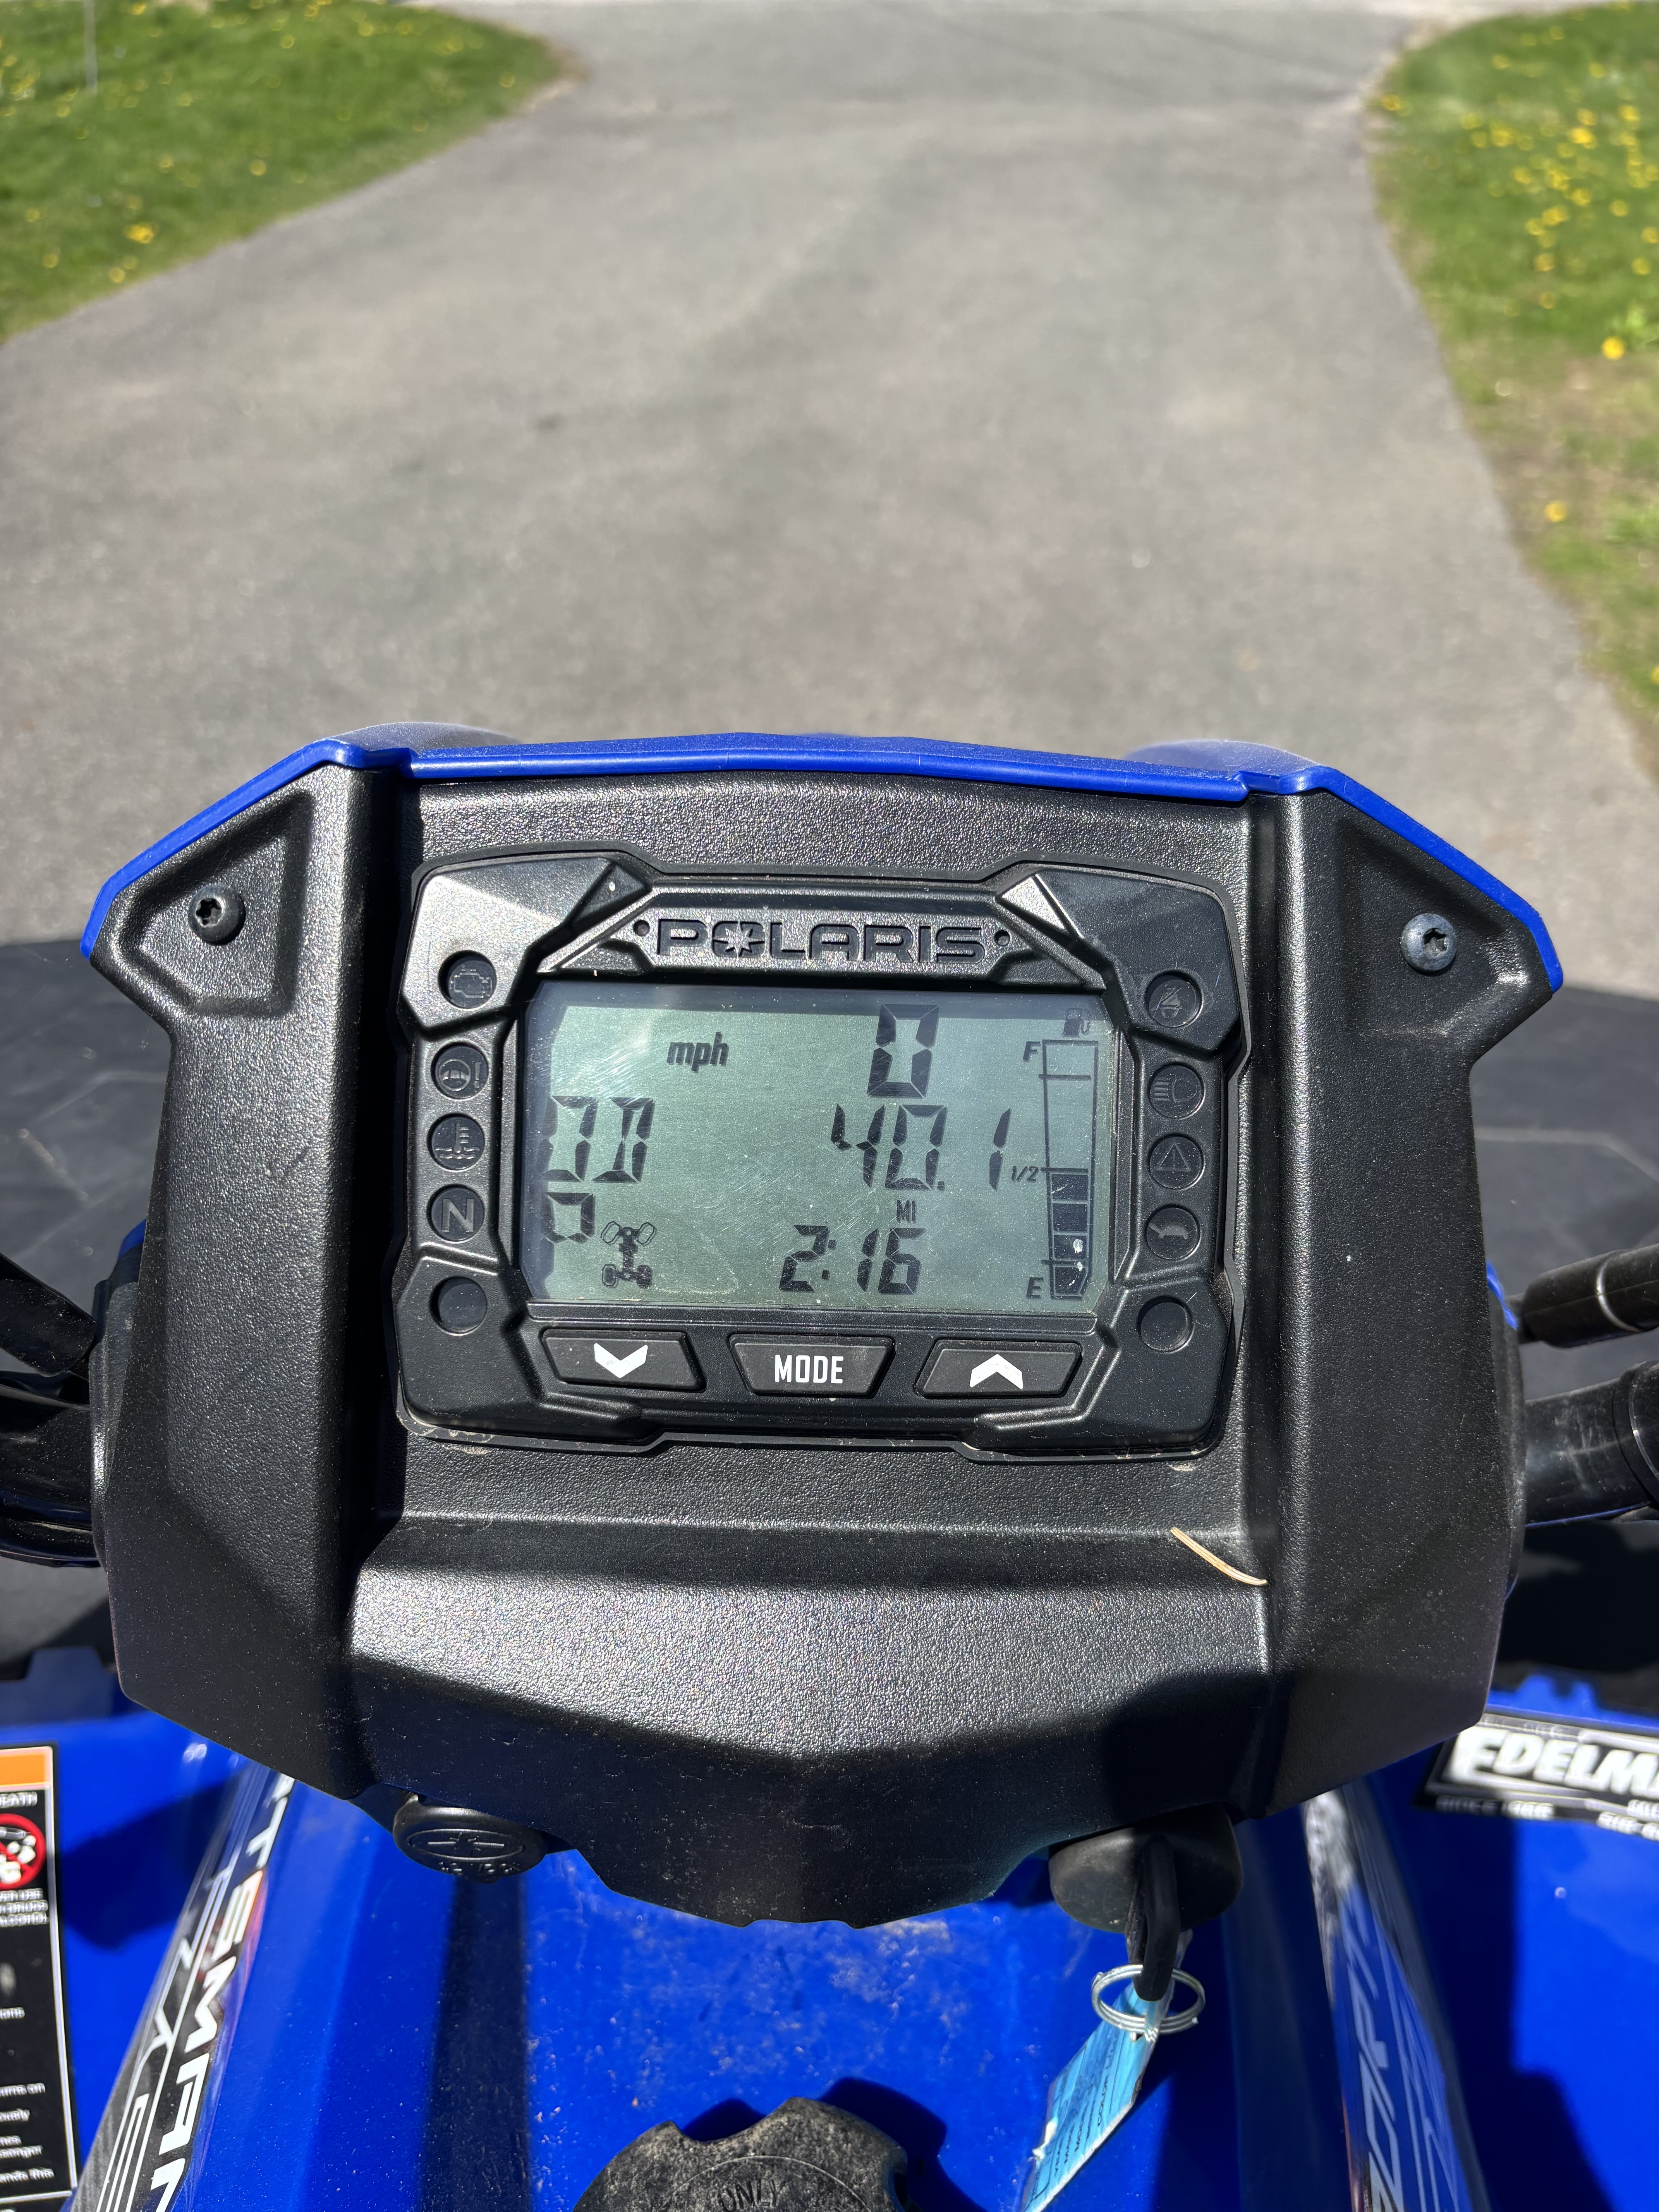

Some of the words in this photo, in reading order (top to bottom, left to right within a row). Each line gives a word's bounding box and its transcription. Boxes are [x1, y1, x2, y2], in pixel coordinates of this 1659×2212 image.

[656, 918, 989, 963] POLARIS
[666, 1031, 730, 1073] mph
[1023, 1041, 1040, 1062] F
[1011, 1166, 1039, 1183] 1/2
[441, 1198, 474, 1232] N
[896, 1199, 917, 1223] MI
[779, 1224, 926, 1296] 2:16
[1026, 1277, 1044, 1298] E
[775, 1354, 844, 1384] MODE
[1446, 1726, 1659, 1799] EDELM
